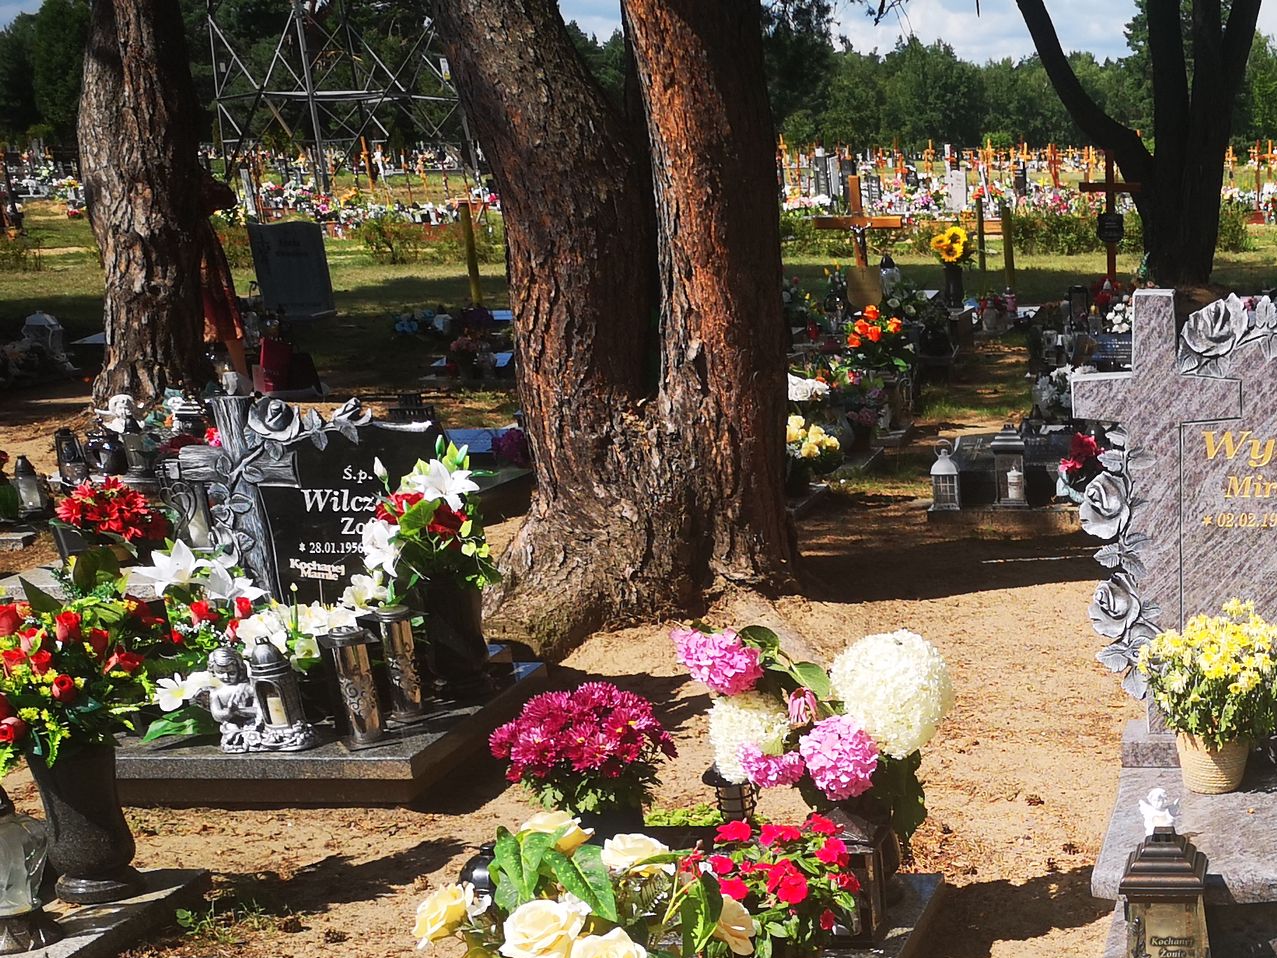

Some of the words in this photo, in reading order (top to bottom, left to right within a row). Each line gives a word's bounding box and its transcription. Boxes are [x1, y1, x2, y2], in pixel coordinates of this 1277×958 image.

[342, 465, 374, 484] Ś.p.
[300, 488, 377, 512] Wilcz
[289, 558, 345, 576] Kochanej
[300, 567, 338, 580] Mamie
